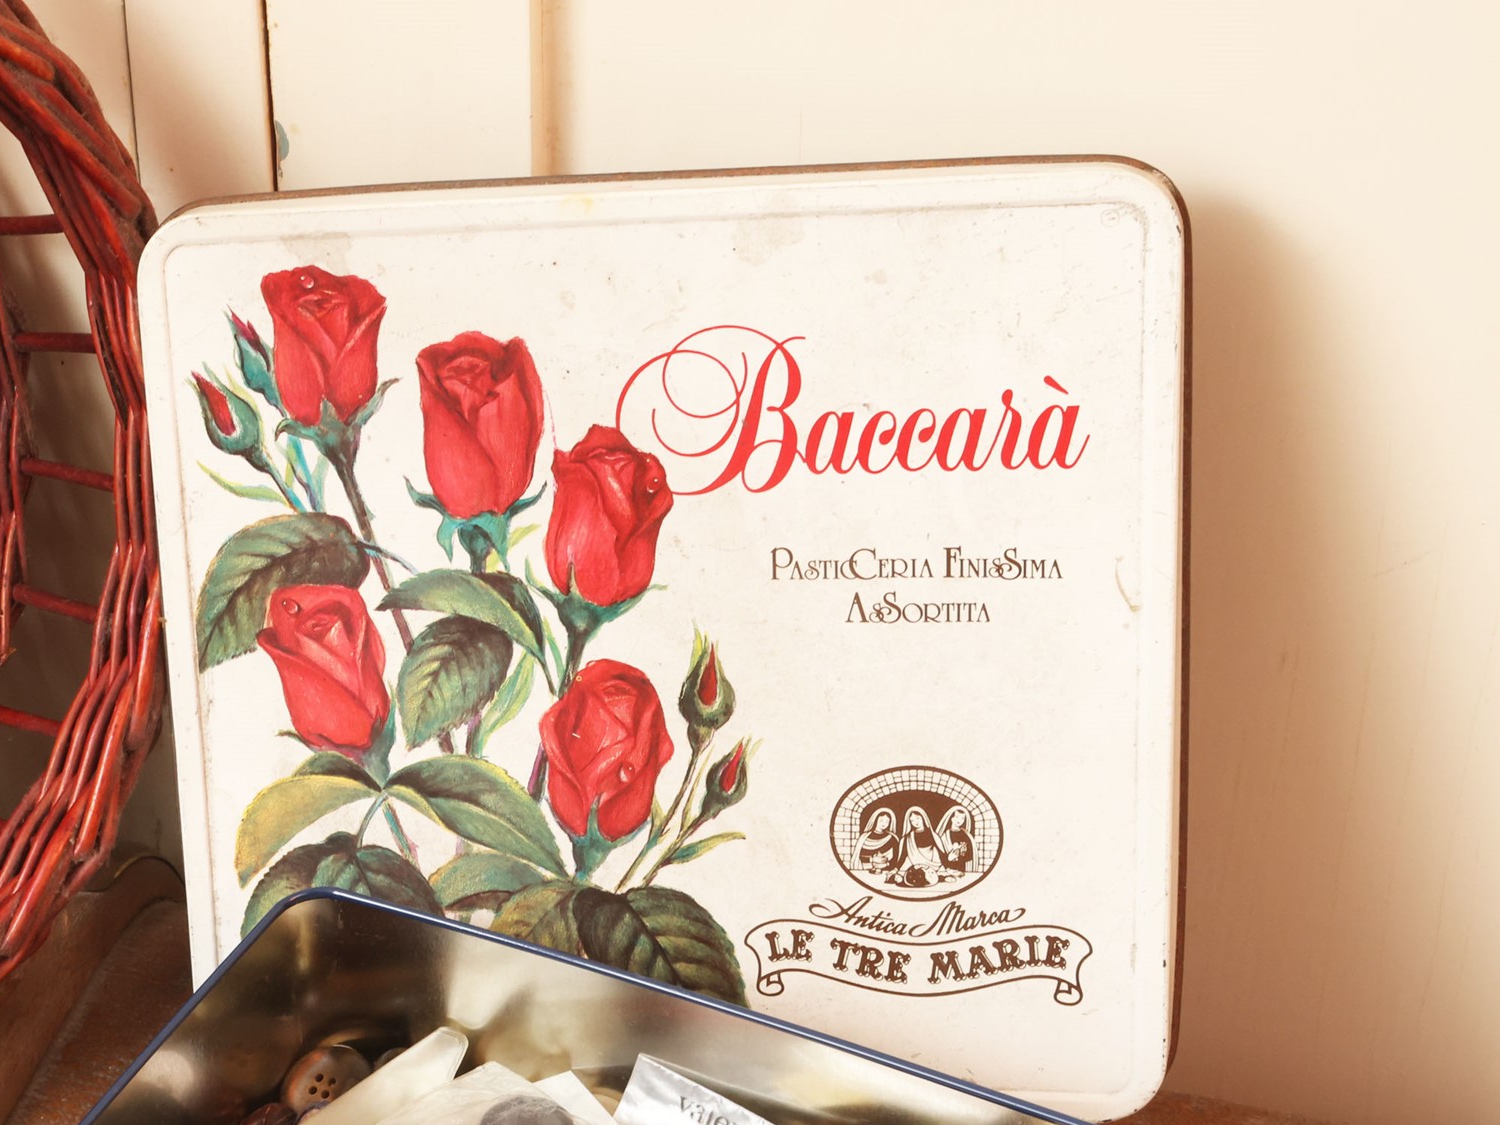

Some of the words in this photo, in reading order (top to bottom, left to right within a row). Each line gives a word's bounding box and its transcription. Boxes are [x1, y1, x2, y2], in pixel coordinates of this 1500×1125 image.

[615, 324, 1091, 497] Baccarà
[809, 895, 908, 937] Antica
[908, 901, 1026, 938] Marca
[765, 929, 815, 962] LE
[830, 938, 911, 985] TRE
[927, 935, 1071, 985] MARIE
